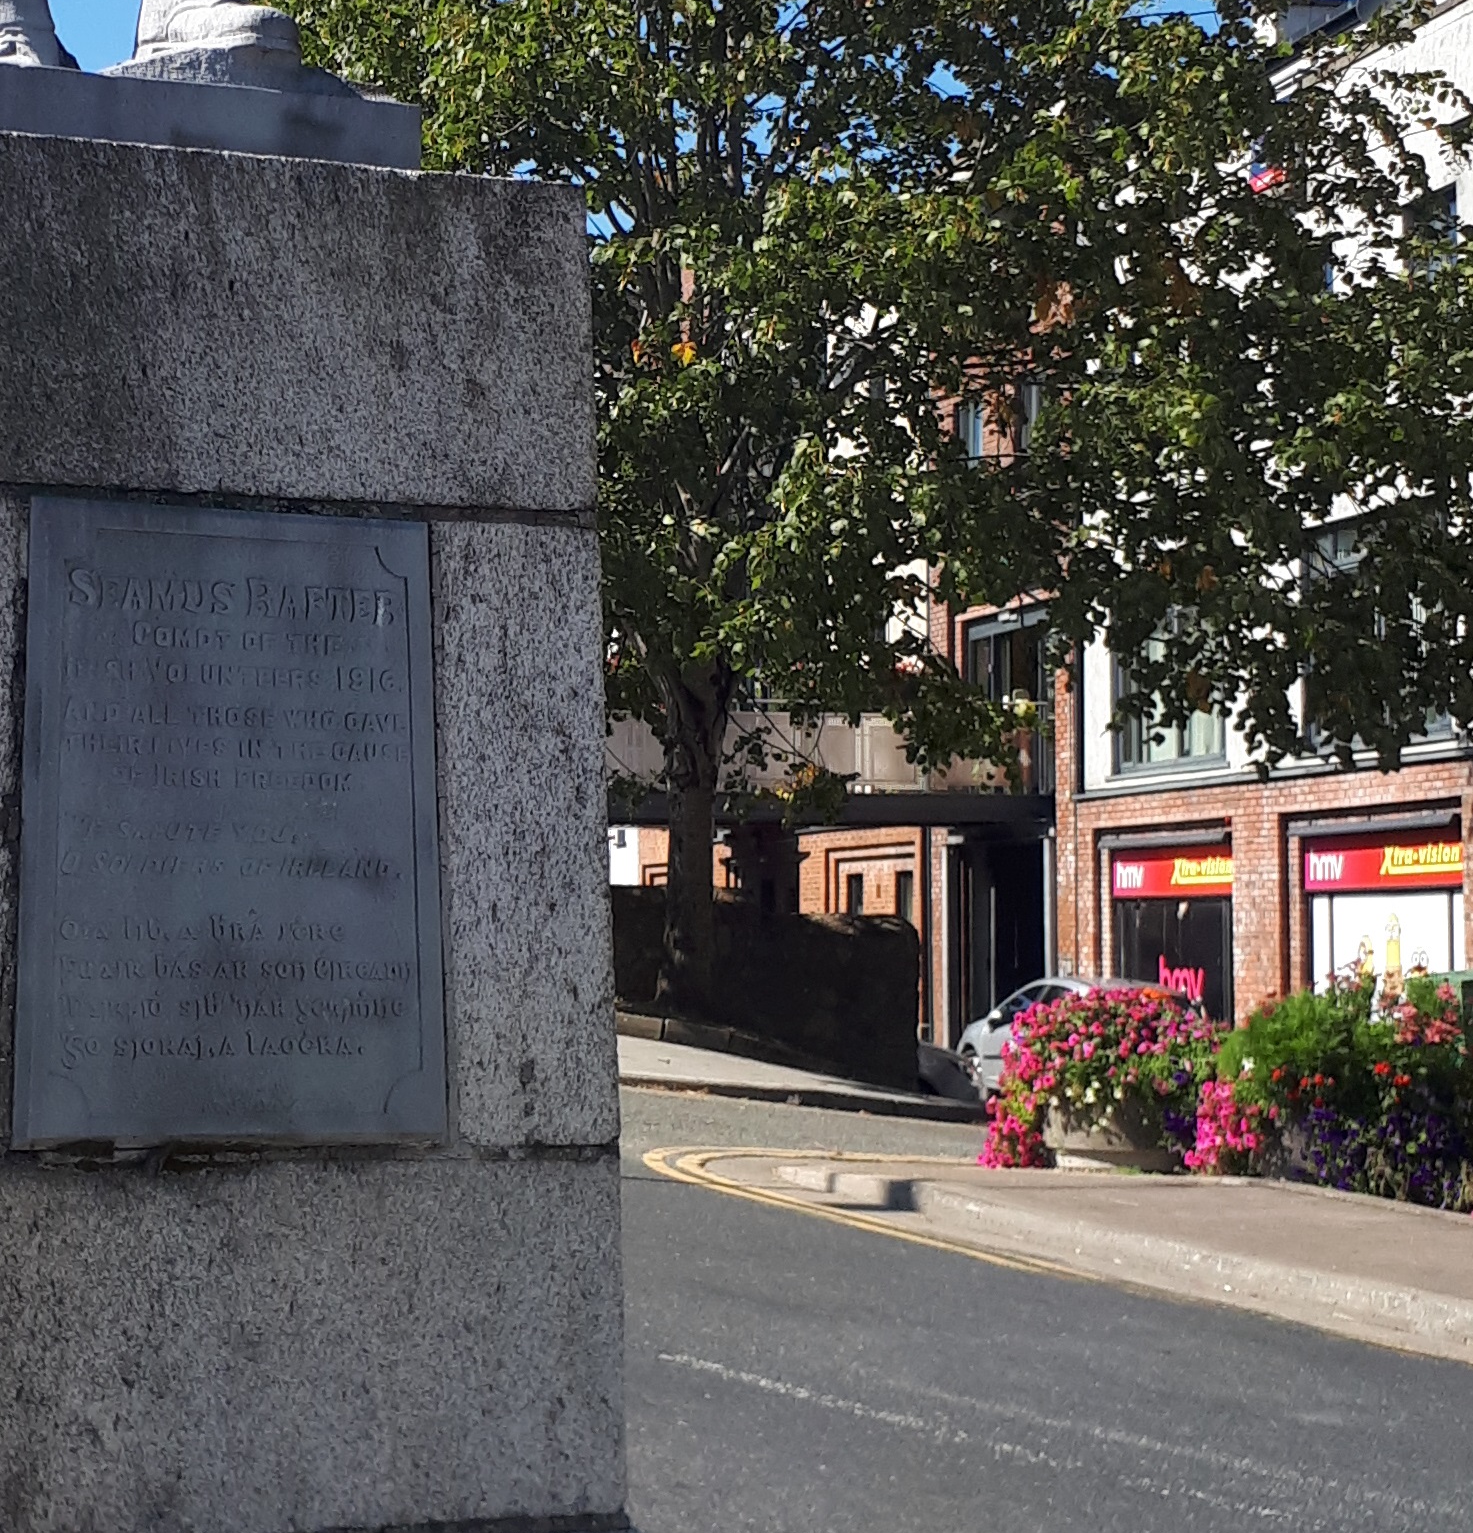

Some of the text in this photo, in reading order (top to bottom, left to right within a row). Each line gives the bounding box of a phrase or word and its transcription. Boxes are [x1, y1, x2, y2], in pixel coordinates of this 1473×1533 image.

[246, 576, 396, 626] RAFTER
[242, 630, 276, 652] OF
[286, 632, 343, 656] THE
[146, 656, 324, 688] VOLUNTEERS
[63, 697, 407, 734] AND ALL THOSE WHO GAVE
[62, 731, 408, 763] THEIR LIVES IN THE CAUSE
[111, 764, 142, 786] OF
[153, 763, 220, 789] IRISH
[63, 812, 102, 842] WE
[118, 820, 221, 842] SALUTE
[92, 850, 224, 876] SOLDIERS
[241, 856, 273, 876] OF
[1116, 861, 1144, 889] hmv
[1309, 850, 1343, 881] hmv
[1159, 954, 1205, 1002] hmv
